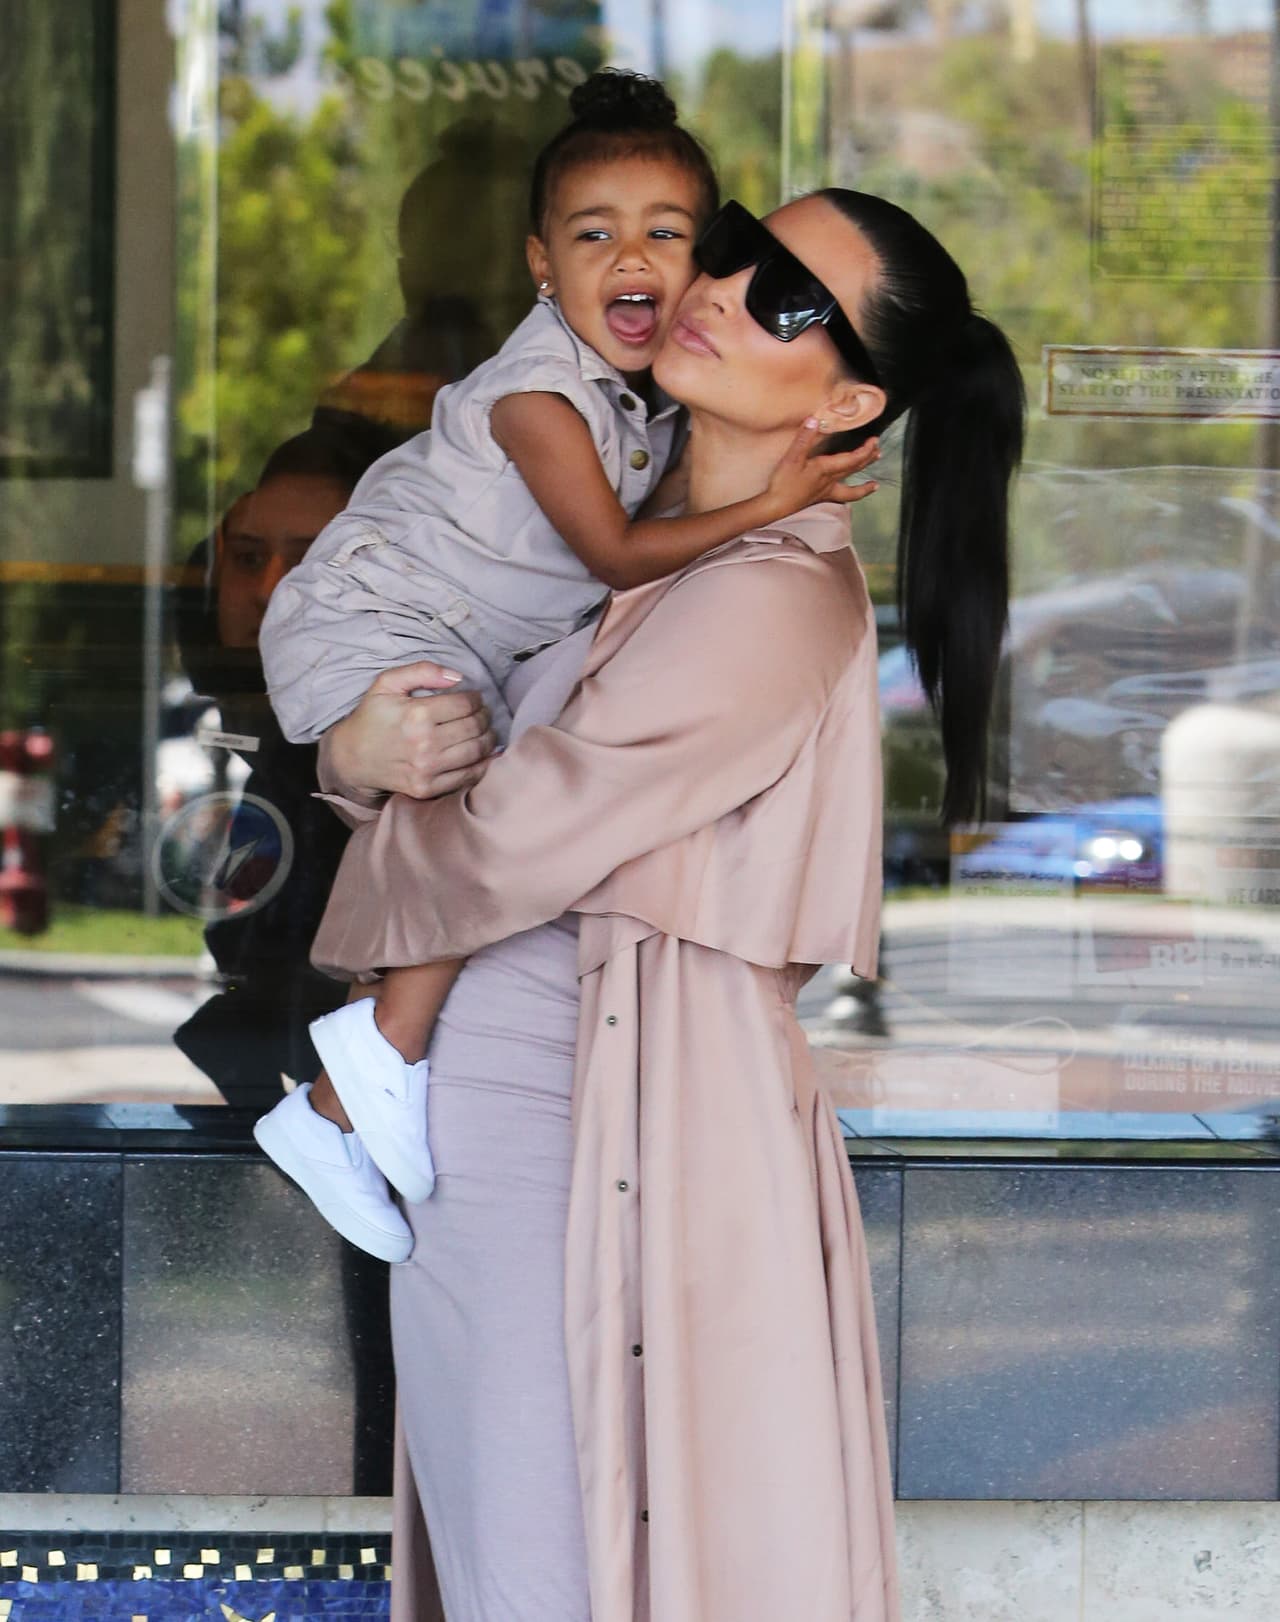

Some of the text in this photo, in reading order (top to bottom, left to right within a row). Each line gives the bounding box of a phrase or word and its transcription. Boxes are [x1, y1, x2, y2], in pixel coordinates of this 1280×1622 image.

[1080, 367, 1104, 380] NO
[1109, 367, 1183, 382] REFUNDS
[1189, 369, 1239, 383] AFTER
[1058, 384, 1107, 397] START
[1112, 385, 1132, 397] OF
[1139, 386, 1170, 398] THE
[1124, 1072, 1187, 1092] DURING
[1191, 1074, 1222, 1094] THE
